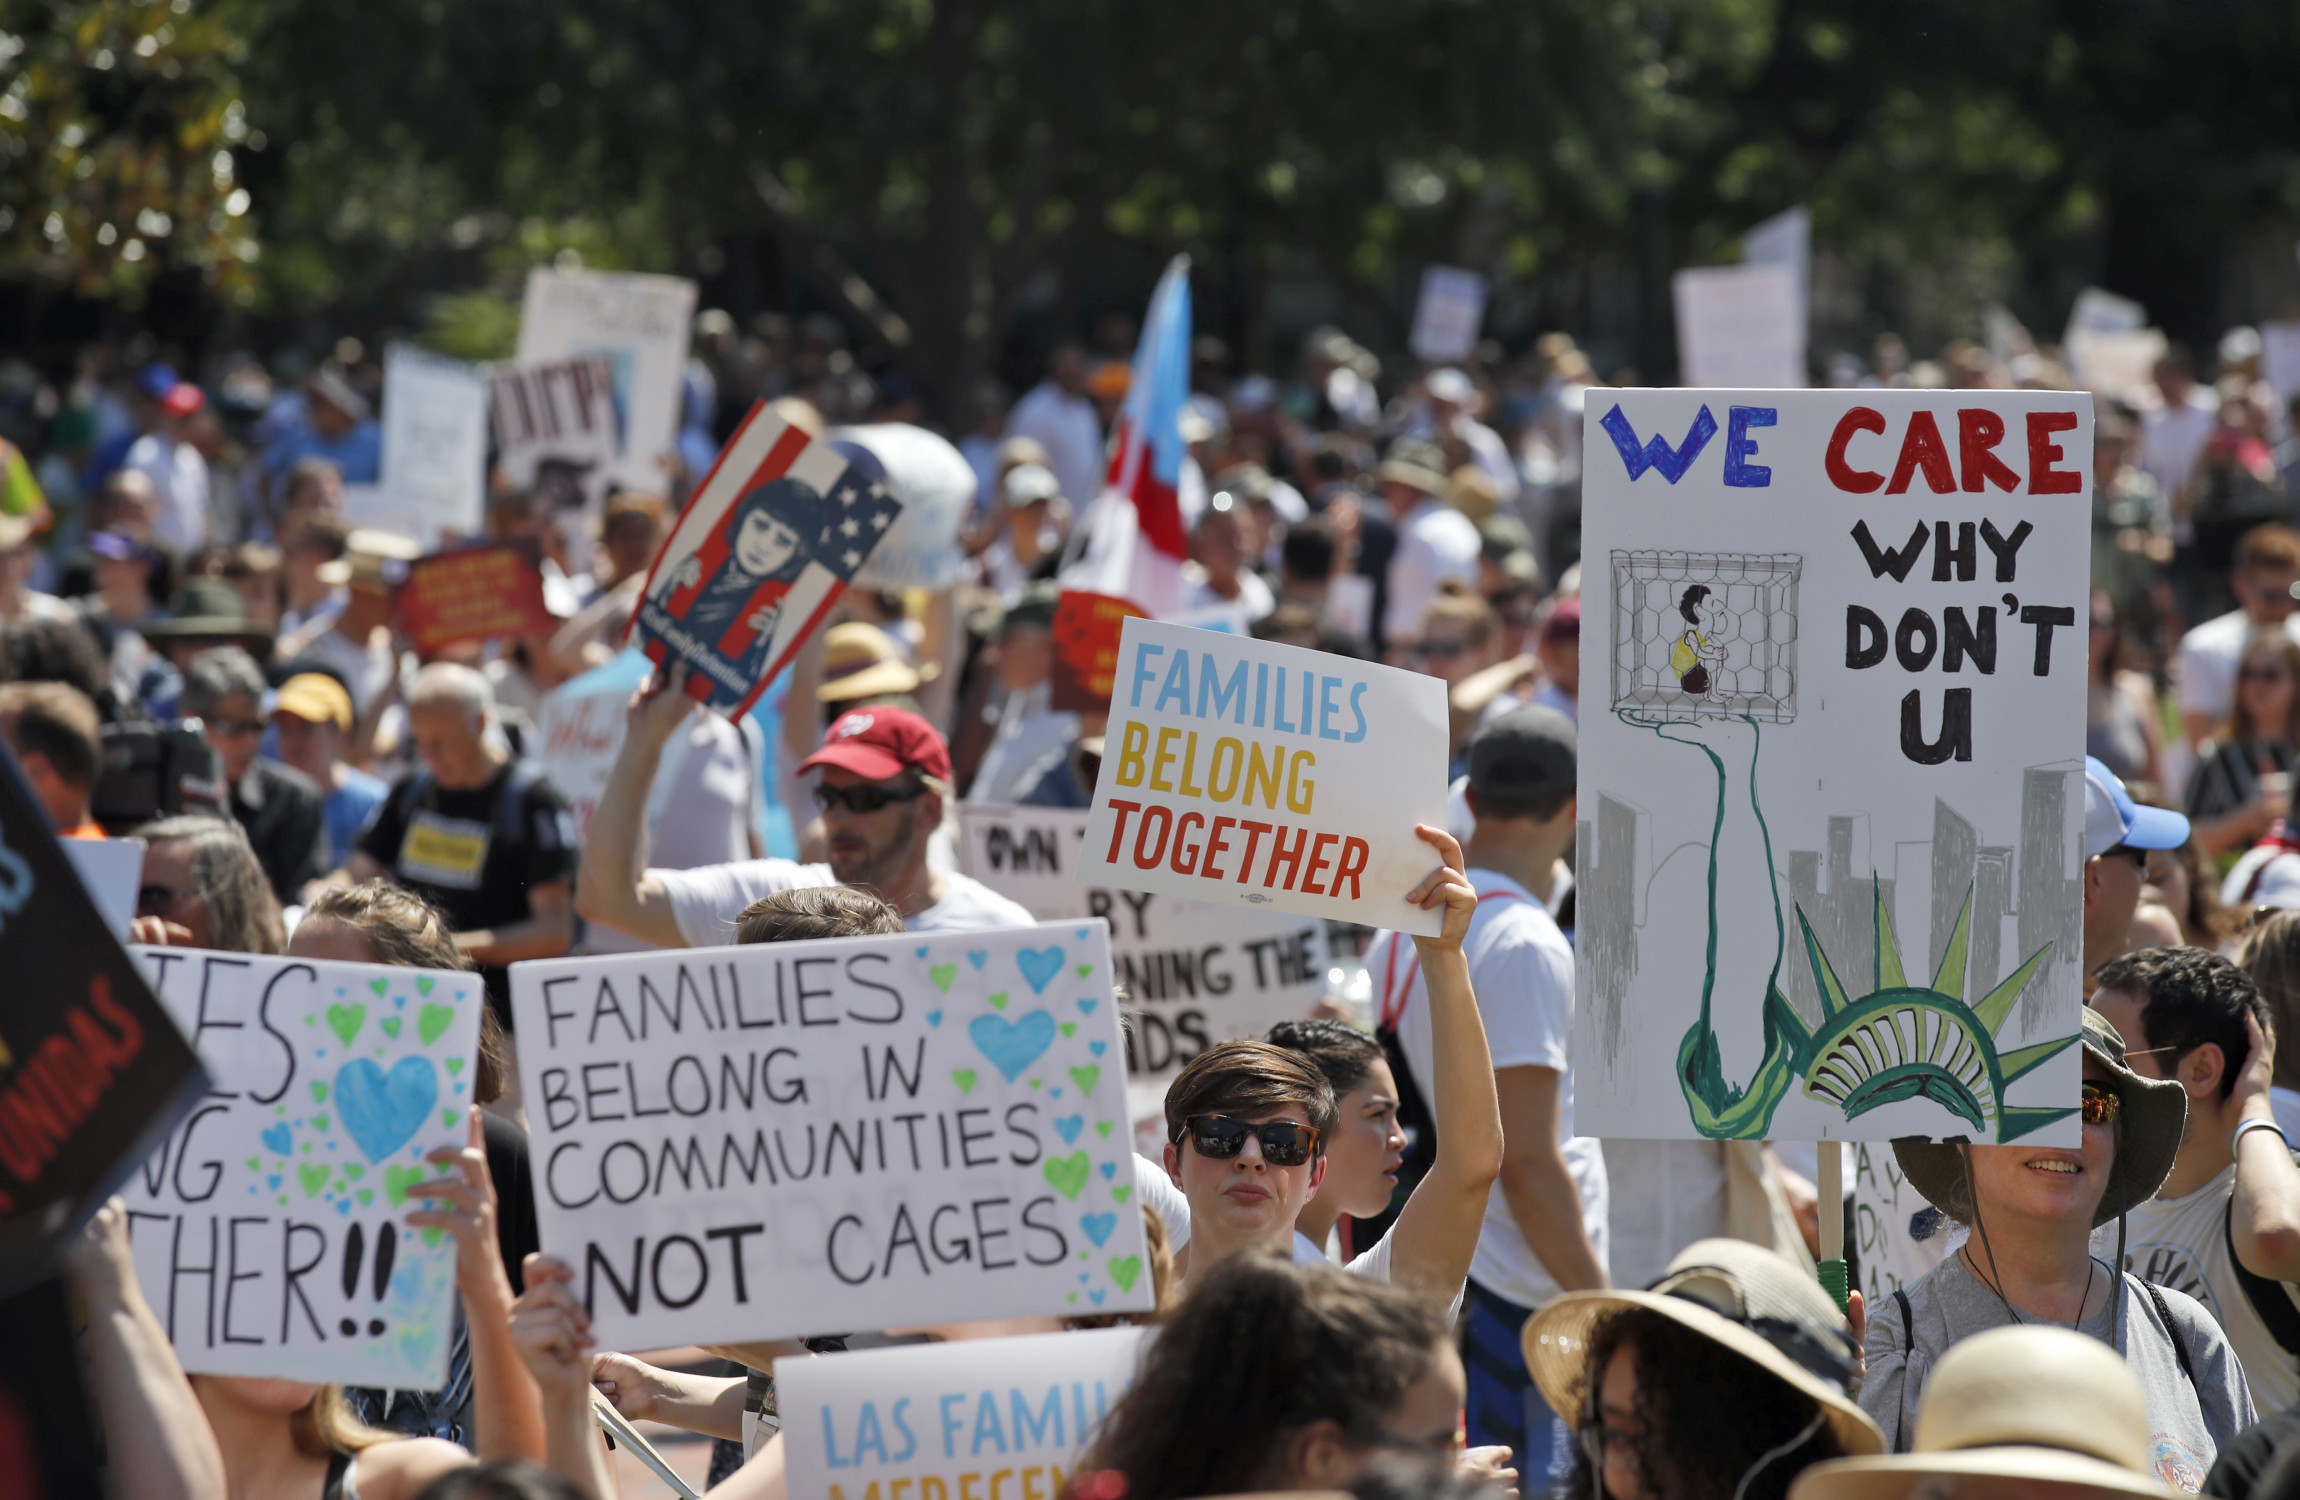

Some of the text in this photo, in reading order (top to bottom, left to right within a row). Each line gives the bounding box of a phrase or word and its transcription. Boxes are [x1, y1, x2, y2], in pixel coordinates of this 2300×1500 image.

[1599, 403, 2082, 495] WE CARE
[1850, 517, 2033, 583] WHY
[1845, 593, 2075, 676] DON'T
[1130, 642, 1367, 743] FAMILIES
[1901, 688, 1972, 765] U
[1115, 720, 1316, 815] BELONG
[1106, 798, 1369, 900] TOGETHER
[1088, 889, 1155, 938] BY
[542, 953, 904, 1048] FAMILIES
[1115, 930, 1323, 1001] NING THE
[541, 1036, 926, 1133] BELONG IN
[546, 1102, 1042, 1209] COMMUNITIES
[585, 1197, 1068, 1321] NOT CAGES
[821, 1397, 917, 1469] LAS
